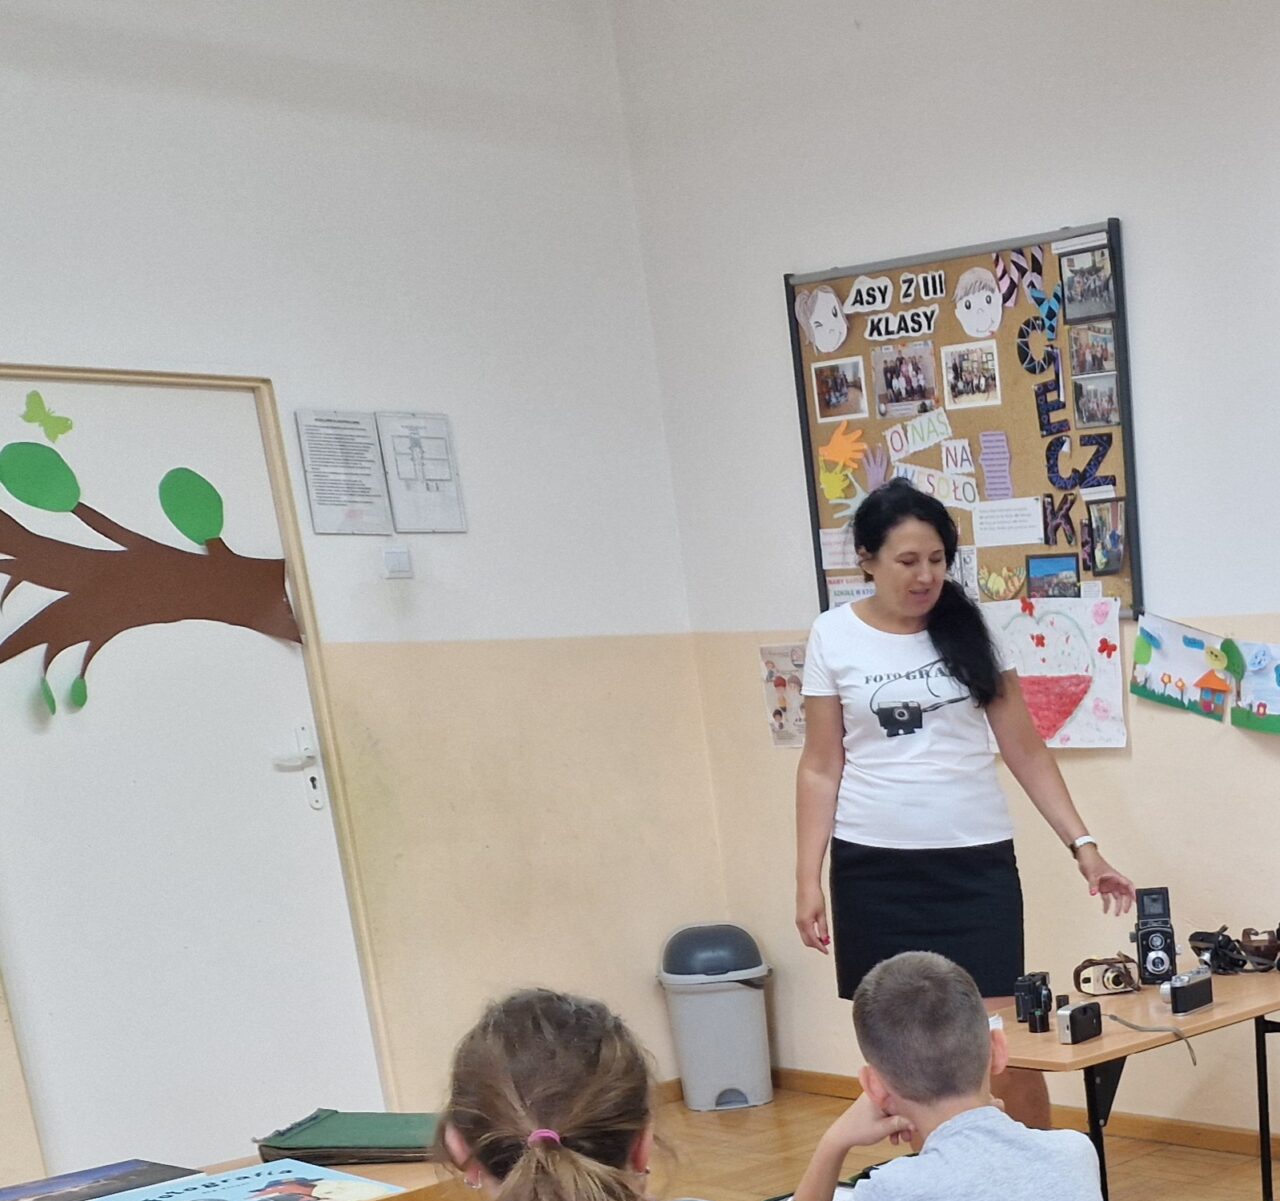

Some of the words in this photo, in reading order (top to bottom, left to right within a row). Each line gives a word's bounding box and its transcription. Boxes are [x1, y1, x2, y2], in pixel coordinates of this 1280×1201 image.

[851, 284, 889, 307] ASY
[902, 277, 916, 299] Z
[922, 273, 944, 297] III
[868, 310, 937, 338] KLASY
[911, 412, 949, 446] NAS
[945, 445, 973, 469] NA
[864, 667, 947, 684] FOTOGRA
